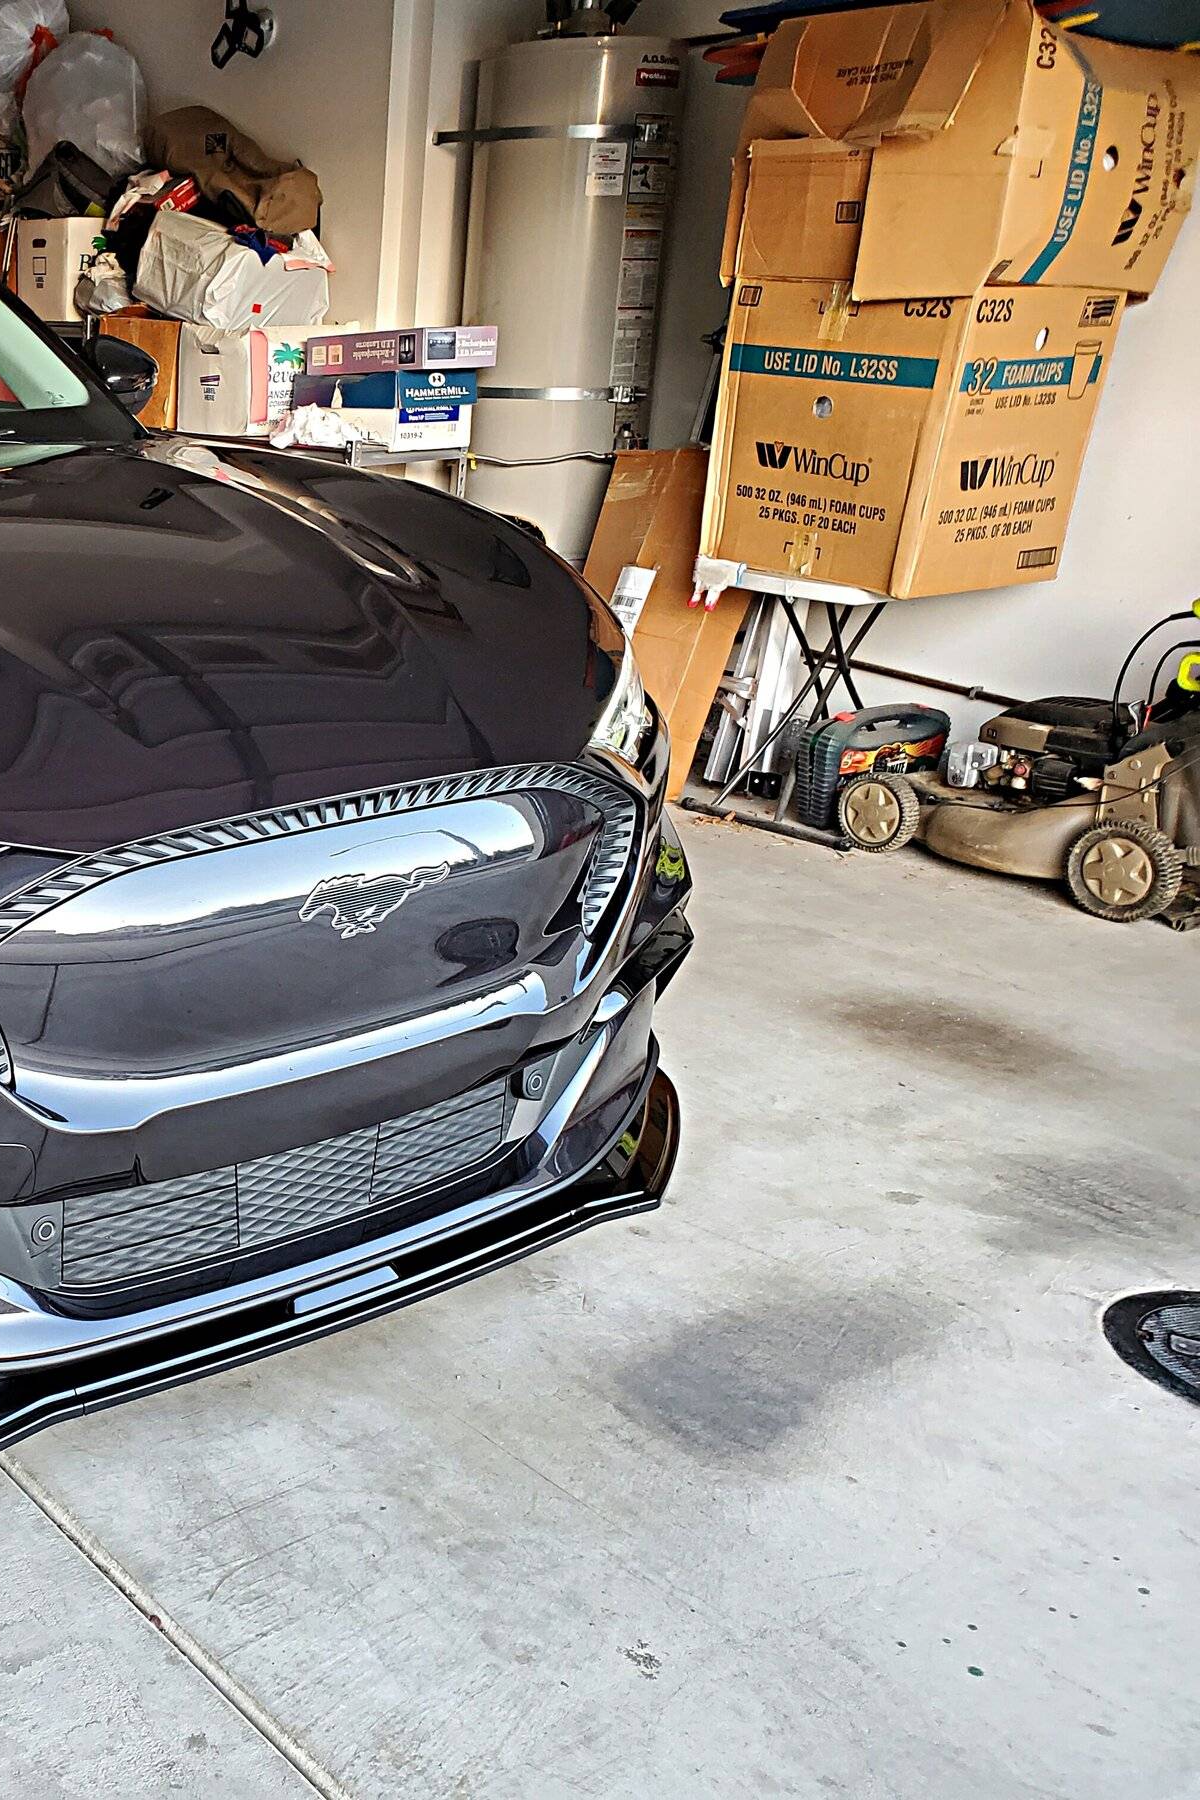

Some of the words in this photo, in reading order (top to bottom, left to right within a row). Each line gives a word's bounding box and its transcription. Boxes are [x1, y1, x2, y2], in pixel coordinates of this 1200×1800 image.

[1054, 206, 1077, 242] USE
[1067, 168, 1086, 201] LID
[976, 298, 1014, 323] C32S
[764, 351, 791, 371] USE
[794, 353, 818, 374] LID
[821, 355, 844, 376] No.
[850, 358, 898, 381] L32SS
[967, 356, 999, 396] 32
[1002, 364, 1035, 386] FOAM
[1035, 362, 1065, 384] CUPS
[995, 395, 1009, 410] USE
[1009, 394, 1022, 409] LID
[1034, 392, 1057, 406] L32SS
[793, 446, 870, 487] WinCup
[992, 453, 1055, 488] WinCup
[736, 484, 753, 498] 500
[755, 487, 766, 500] 32
[768, 489, 784, 504] OZ.
[786, 492, 806, 508] (946
[809, 496, 827, 513] mL)
[829, 499, 856, 516] FOAM
[859, 505, 886, 522] CUPS
[938, 510, 953, 525] 500
[954, 509, 965, 523] 32
[966, 506, 978, 522] OZ.
[979, 504, 997, 523] (946
[1013, 500, 1035, 516] FOAM
[1035, 497, 1056, 512] CUPS
[758, 506, 770, 519] 25
[772, 508, 800, 525] PKGS.
[803, 513, 816, 527] OF
[818, 516, 829, 529] 20
[831, 518, 857, 535] EACH
[954, 528, 965, 543] 25
[966, 525, 988, 542] PKGS.
[991, 524, 1001, 538] OF
[1001, 522, 1013, 536] 20
[1012, 520, 1033, 535] EACH
